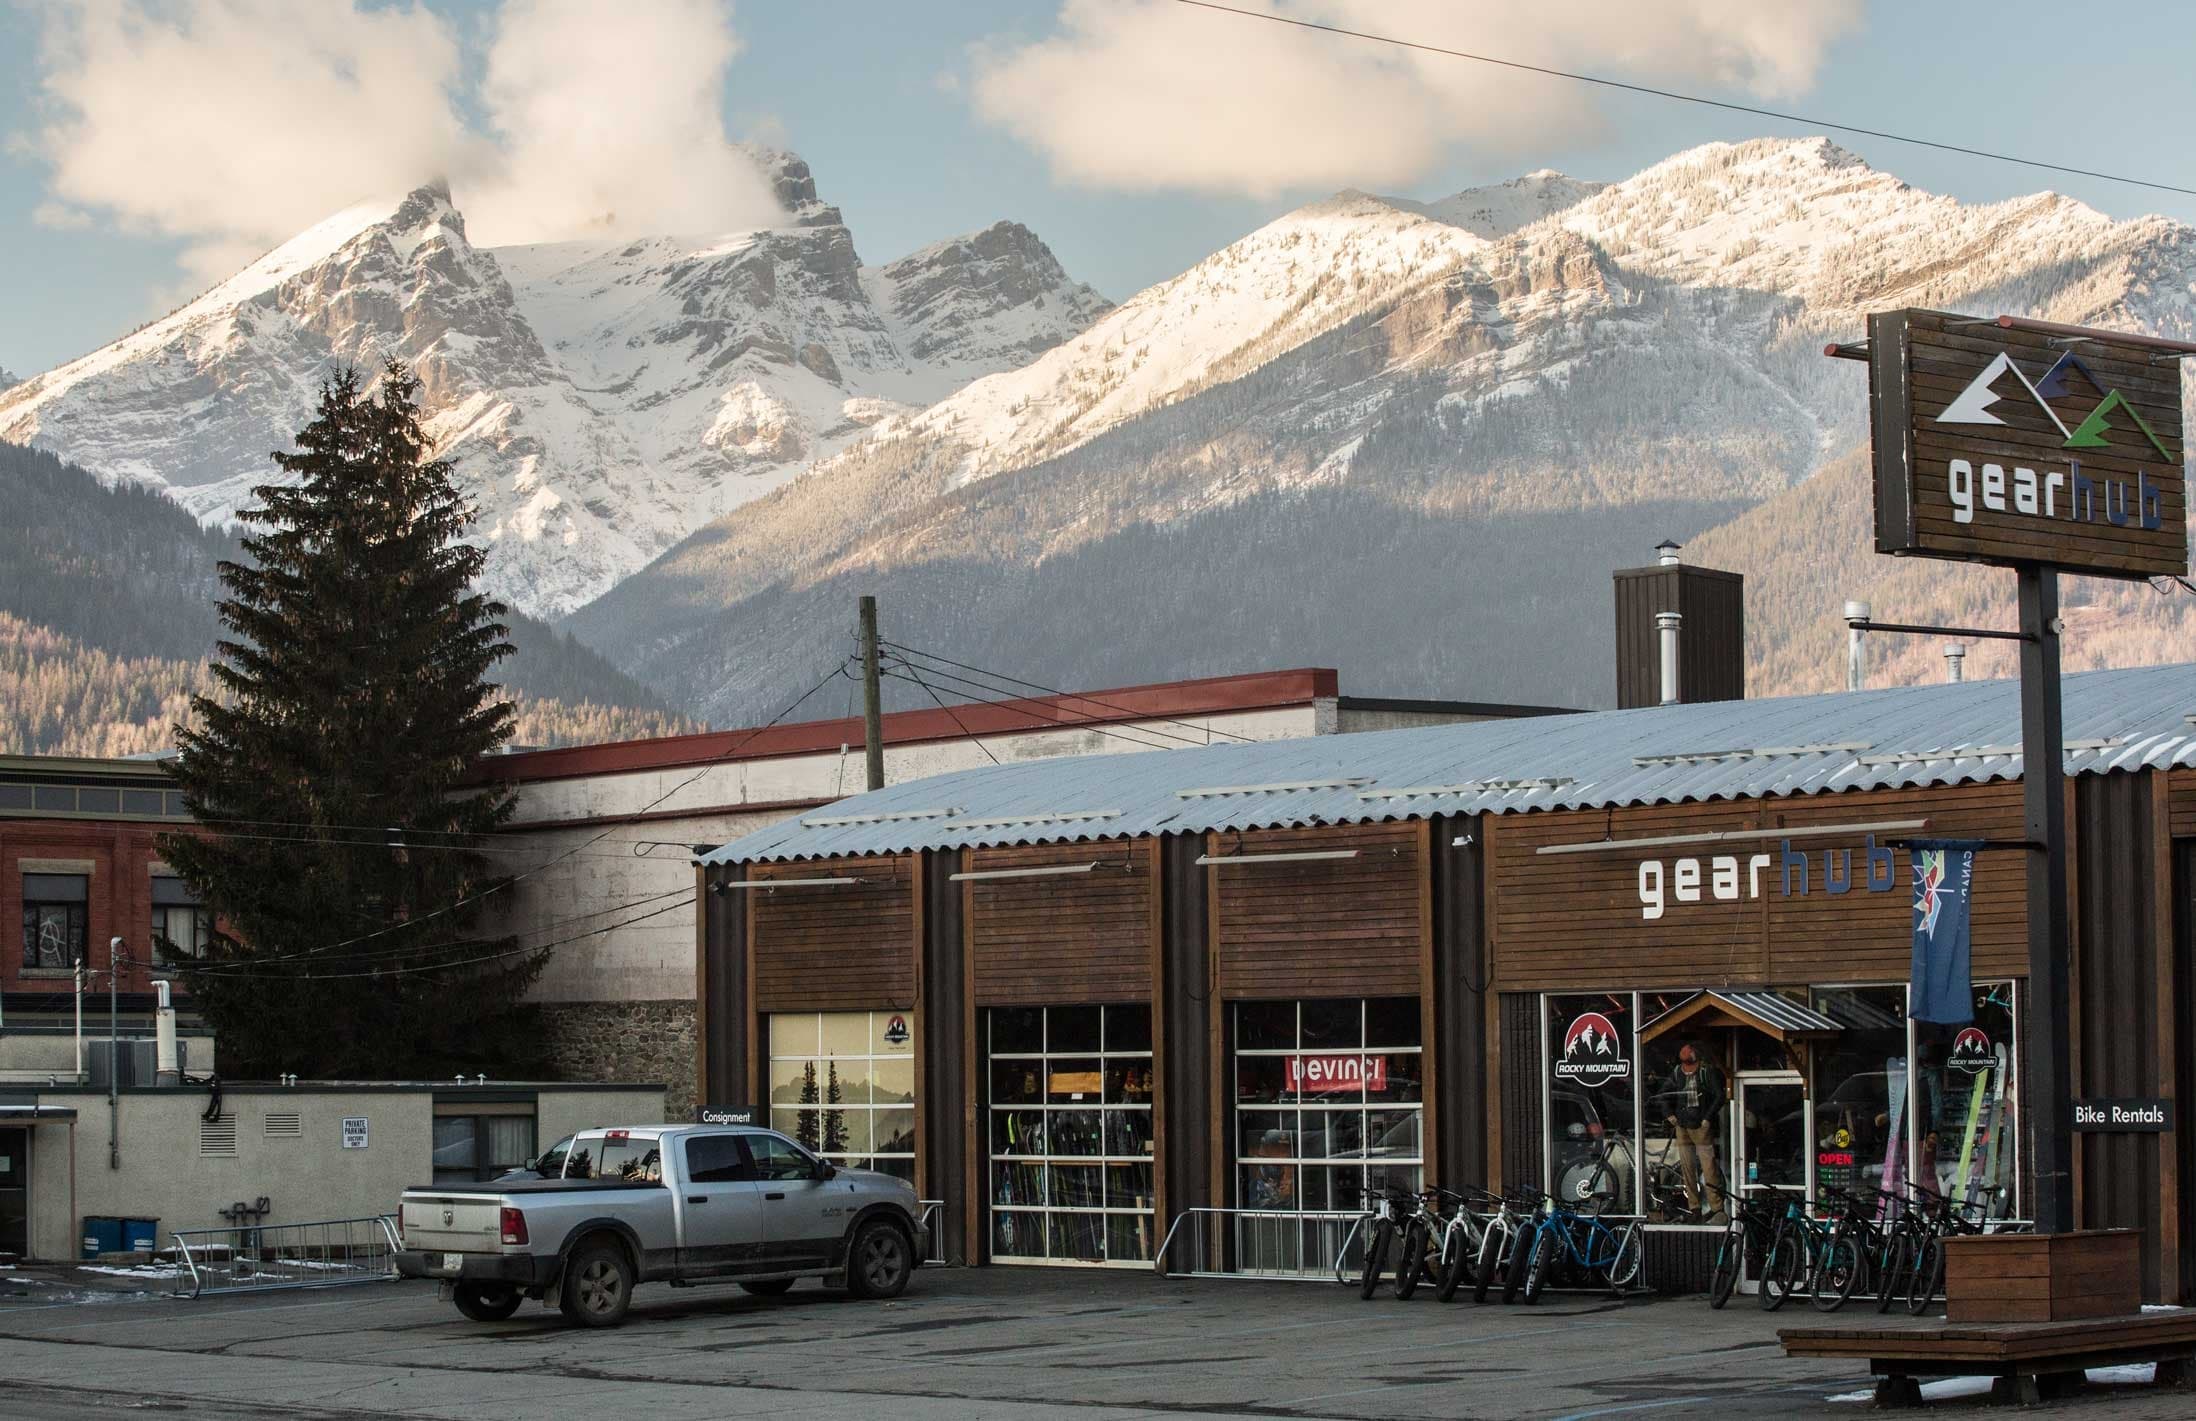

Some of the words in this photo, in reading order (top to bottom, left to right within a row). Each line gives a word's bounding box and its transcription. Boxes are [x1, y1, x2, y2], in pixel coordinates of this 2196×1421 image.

[1559, 1064, 1585, 1072] ROCKY
[1585, 1064, 1626, 1072] MOUNTAIN
[702, 1110, 751, 1125] Consignment
[2075, 1105, 2106, 1123] Bike
[2112, 1105, 2164, 1123] Rentals
[345, 1119, 365, 1127] PRIVATE
[1818, 1153, 1853, 1165] OPEN
